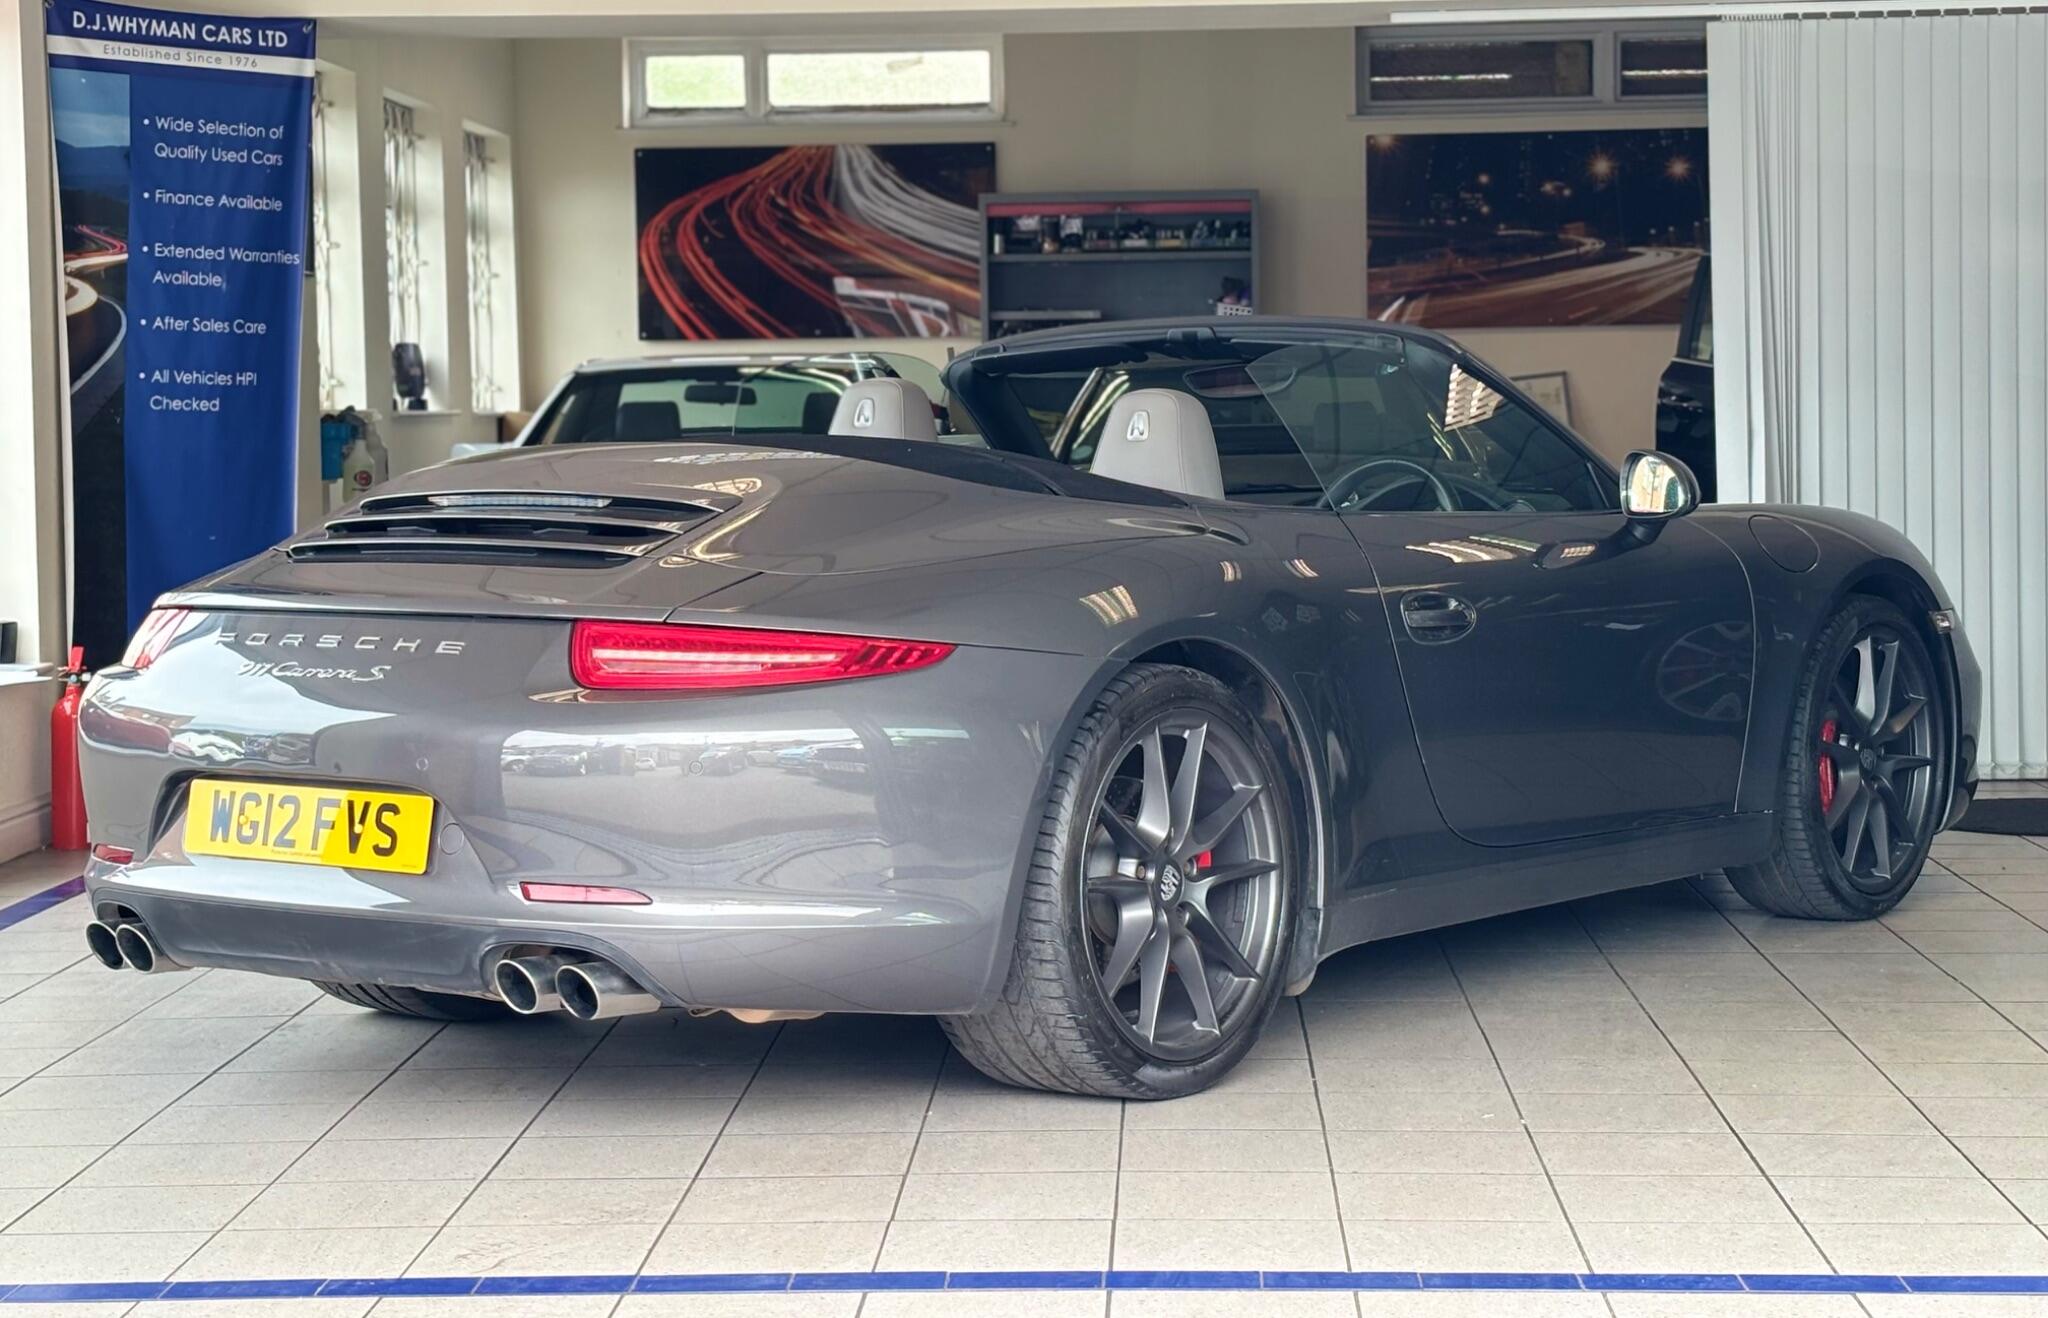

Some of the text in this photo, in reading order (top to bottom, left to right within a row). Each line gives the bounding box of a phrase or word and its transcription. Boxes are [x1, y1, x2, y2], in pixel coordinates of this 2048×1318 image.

[202, 24, 252, 45] CARS
[258, 30, 288, 48] LTD
[103, 44, 258, 69] Established Since 1976
[155, 116, 284, 140] Wide Selection of
[154, 143, 283, 166] Quality Used Cars
[155, 189, 283, 211] Finance Available
[154, 243, 300, 265] Extended Warranties
[152, 316, 267, 335] After Sales Care
[151, 369, 257, 386] All Vehicles HPI
[150, 395, 220, 412] Checked
[216, 631, 466, 655] PORSCHE
[272, 661, 357, 680] Carrera
[353, 665, 392, 682] S
[210, 789, 401, 857] WG12 FVS
